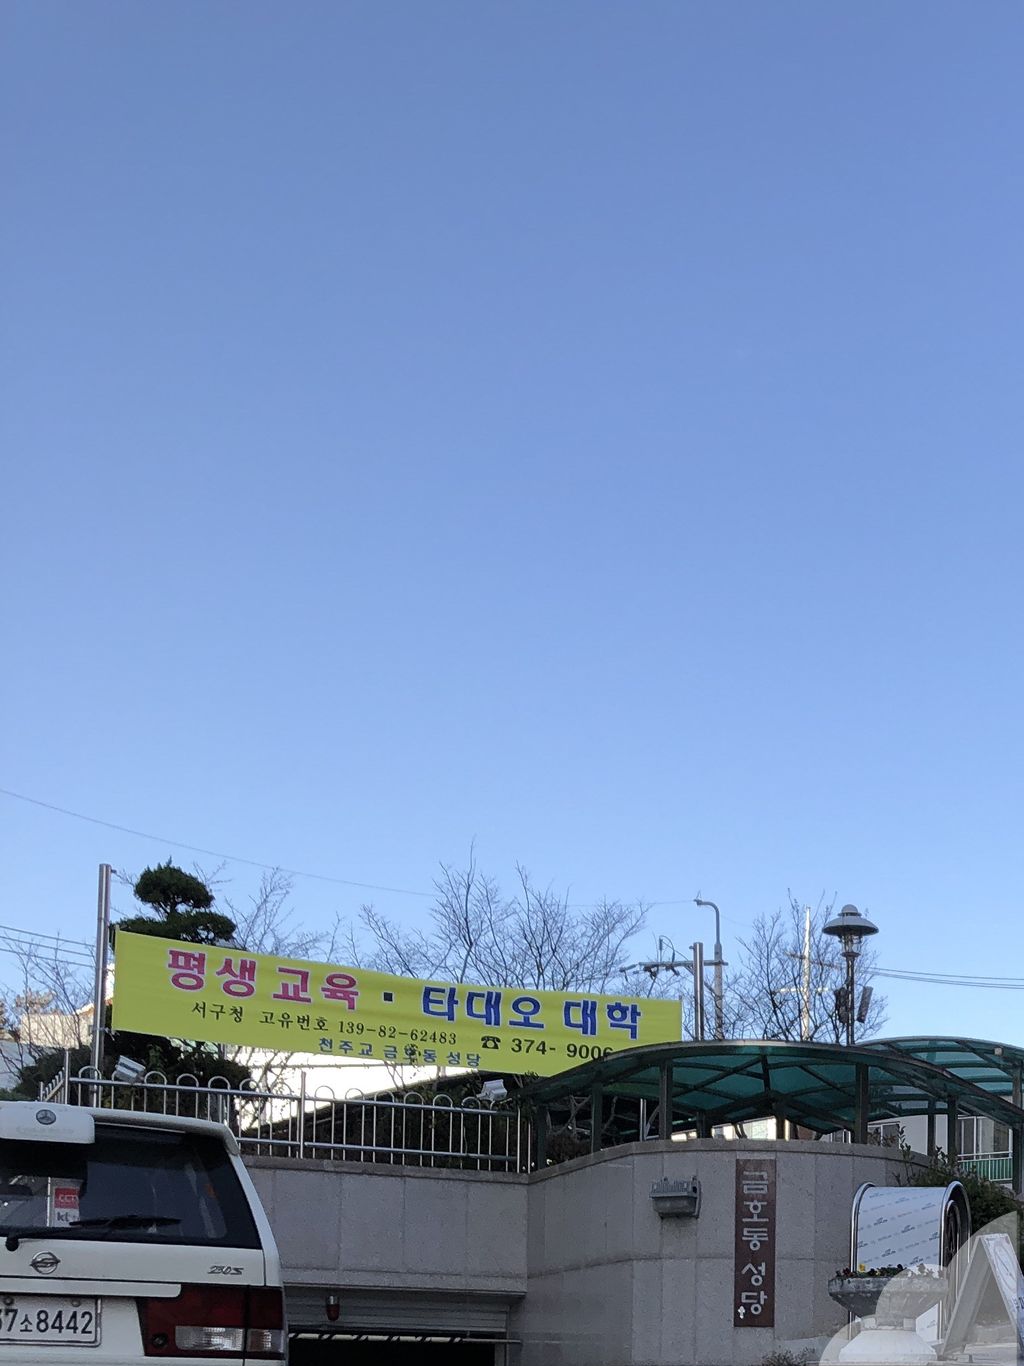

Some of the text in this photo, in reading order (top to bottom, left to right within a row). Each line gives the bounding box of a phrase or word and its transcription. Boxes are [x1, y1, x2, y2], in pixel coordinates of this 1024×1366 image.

[168, 950, 642, 1040] 평생교육 타대오 대학
[192, 1001, 457, 1045] 서구청 고유번호 139-82-62483
[319, 1037, 373, 1056] 천주교
[446, 1051, 481, 1068] 성당
[741, 1171, 769, 1315] 금호동 성당
[0, 1308, 93, 1335] 7소8442
